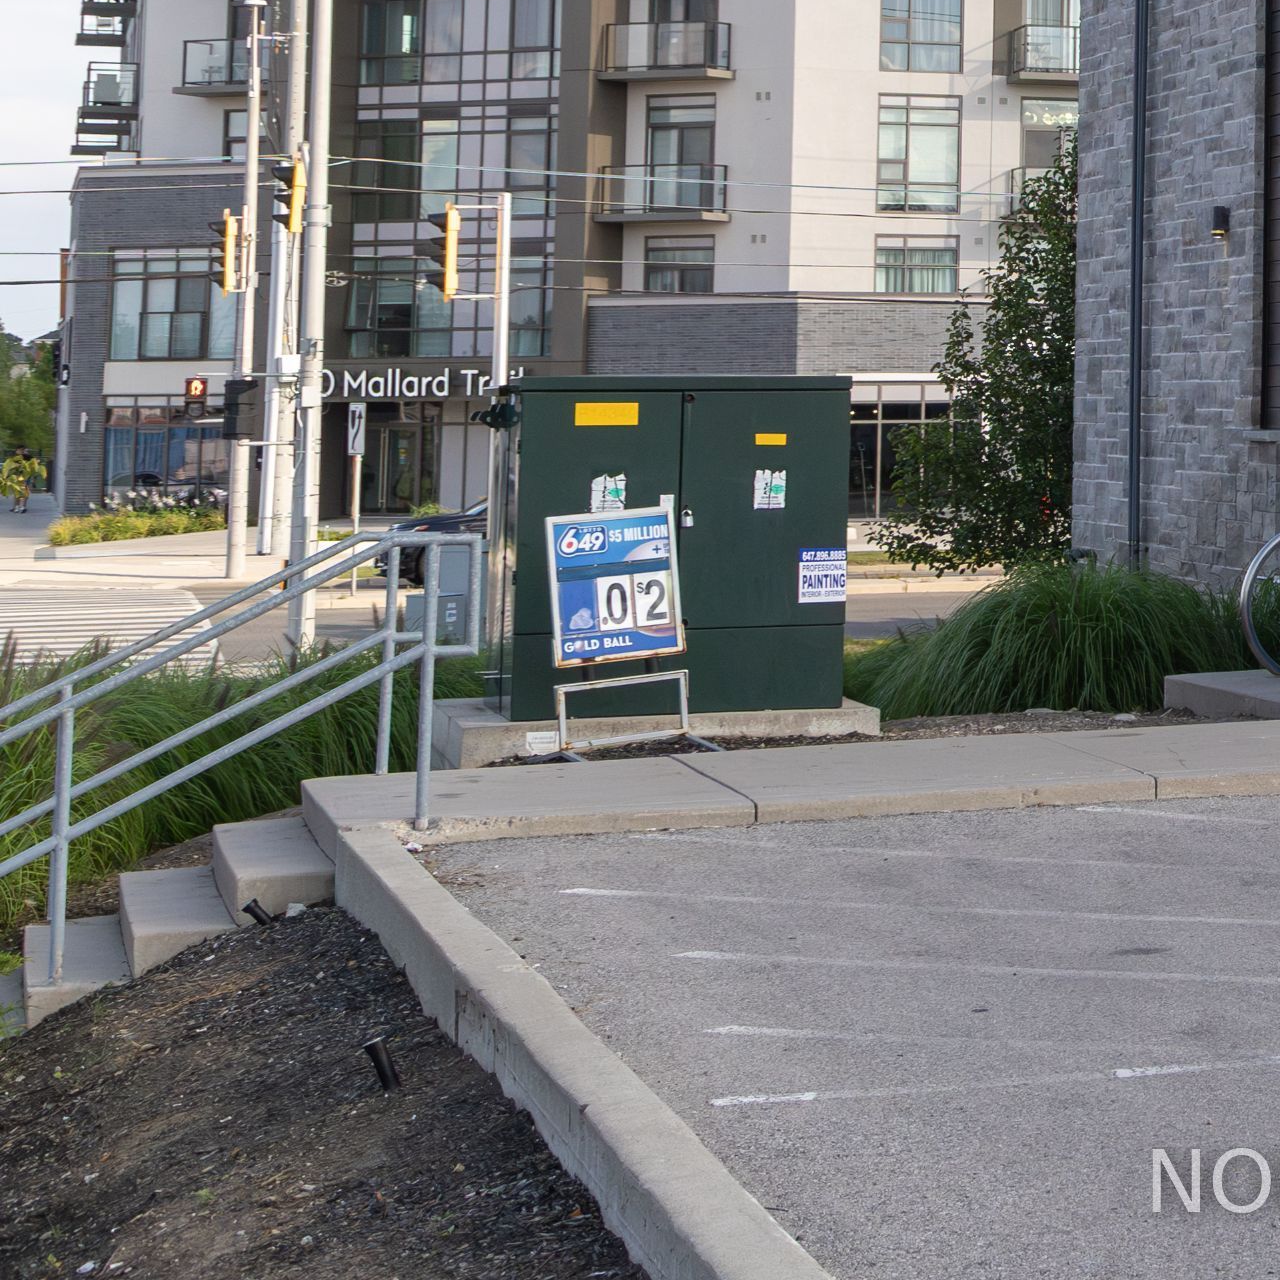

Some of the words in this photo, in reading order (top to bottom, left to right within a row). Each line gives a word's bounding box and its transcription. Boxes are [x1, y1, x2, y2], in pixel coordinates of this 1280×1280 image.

[343, 367, 450, 397] Mallard
[560, 528, 604, 554] 649
[609, 529, 622, 542] $5
[624, 524, 668, 541] MILLION
[802, 564, 845, 572] PROFESSIONAL
[802, 573, 846, 589] PAINTING
[603, 635, 633, 649] BALL
